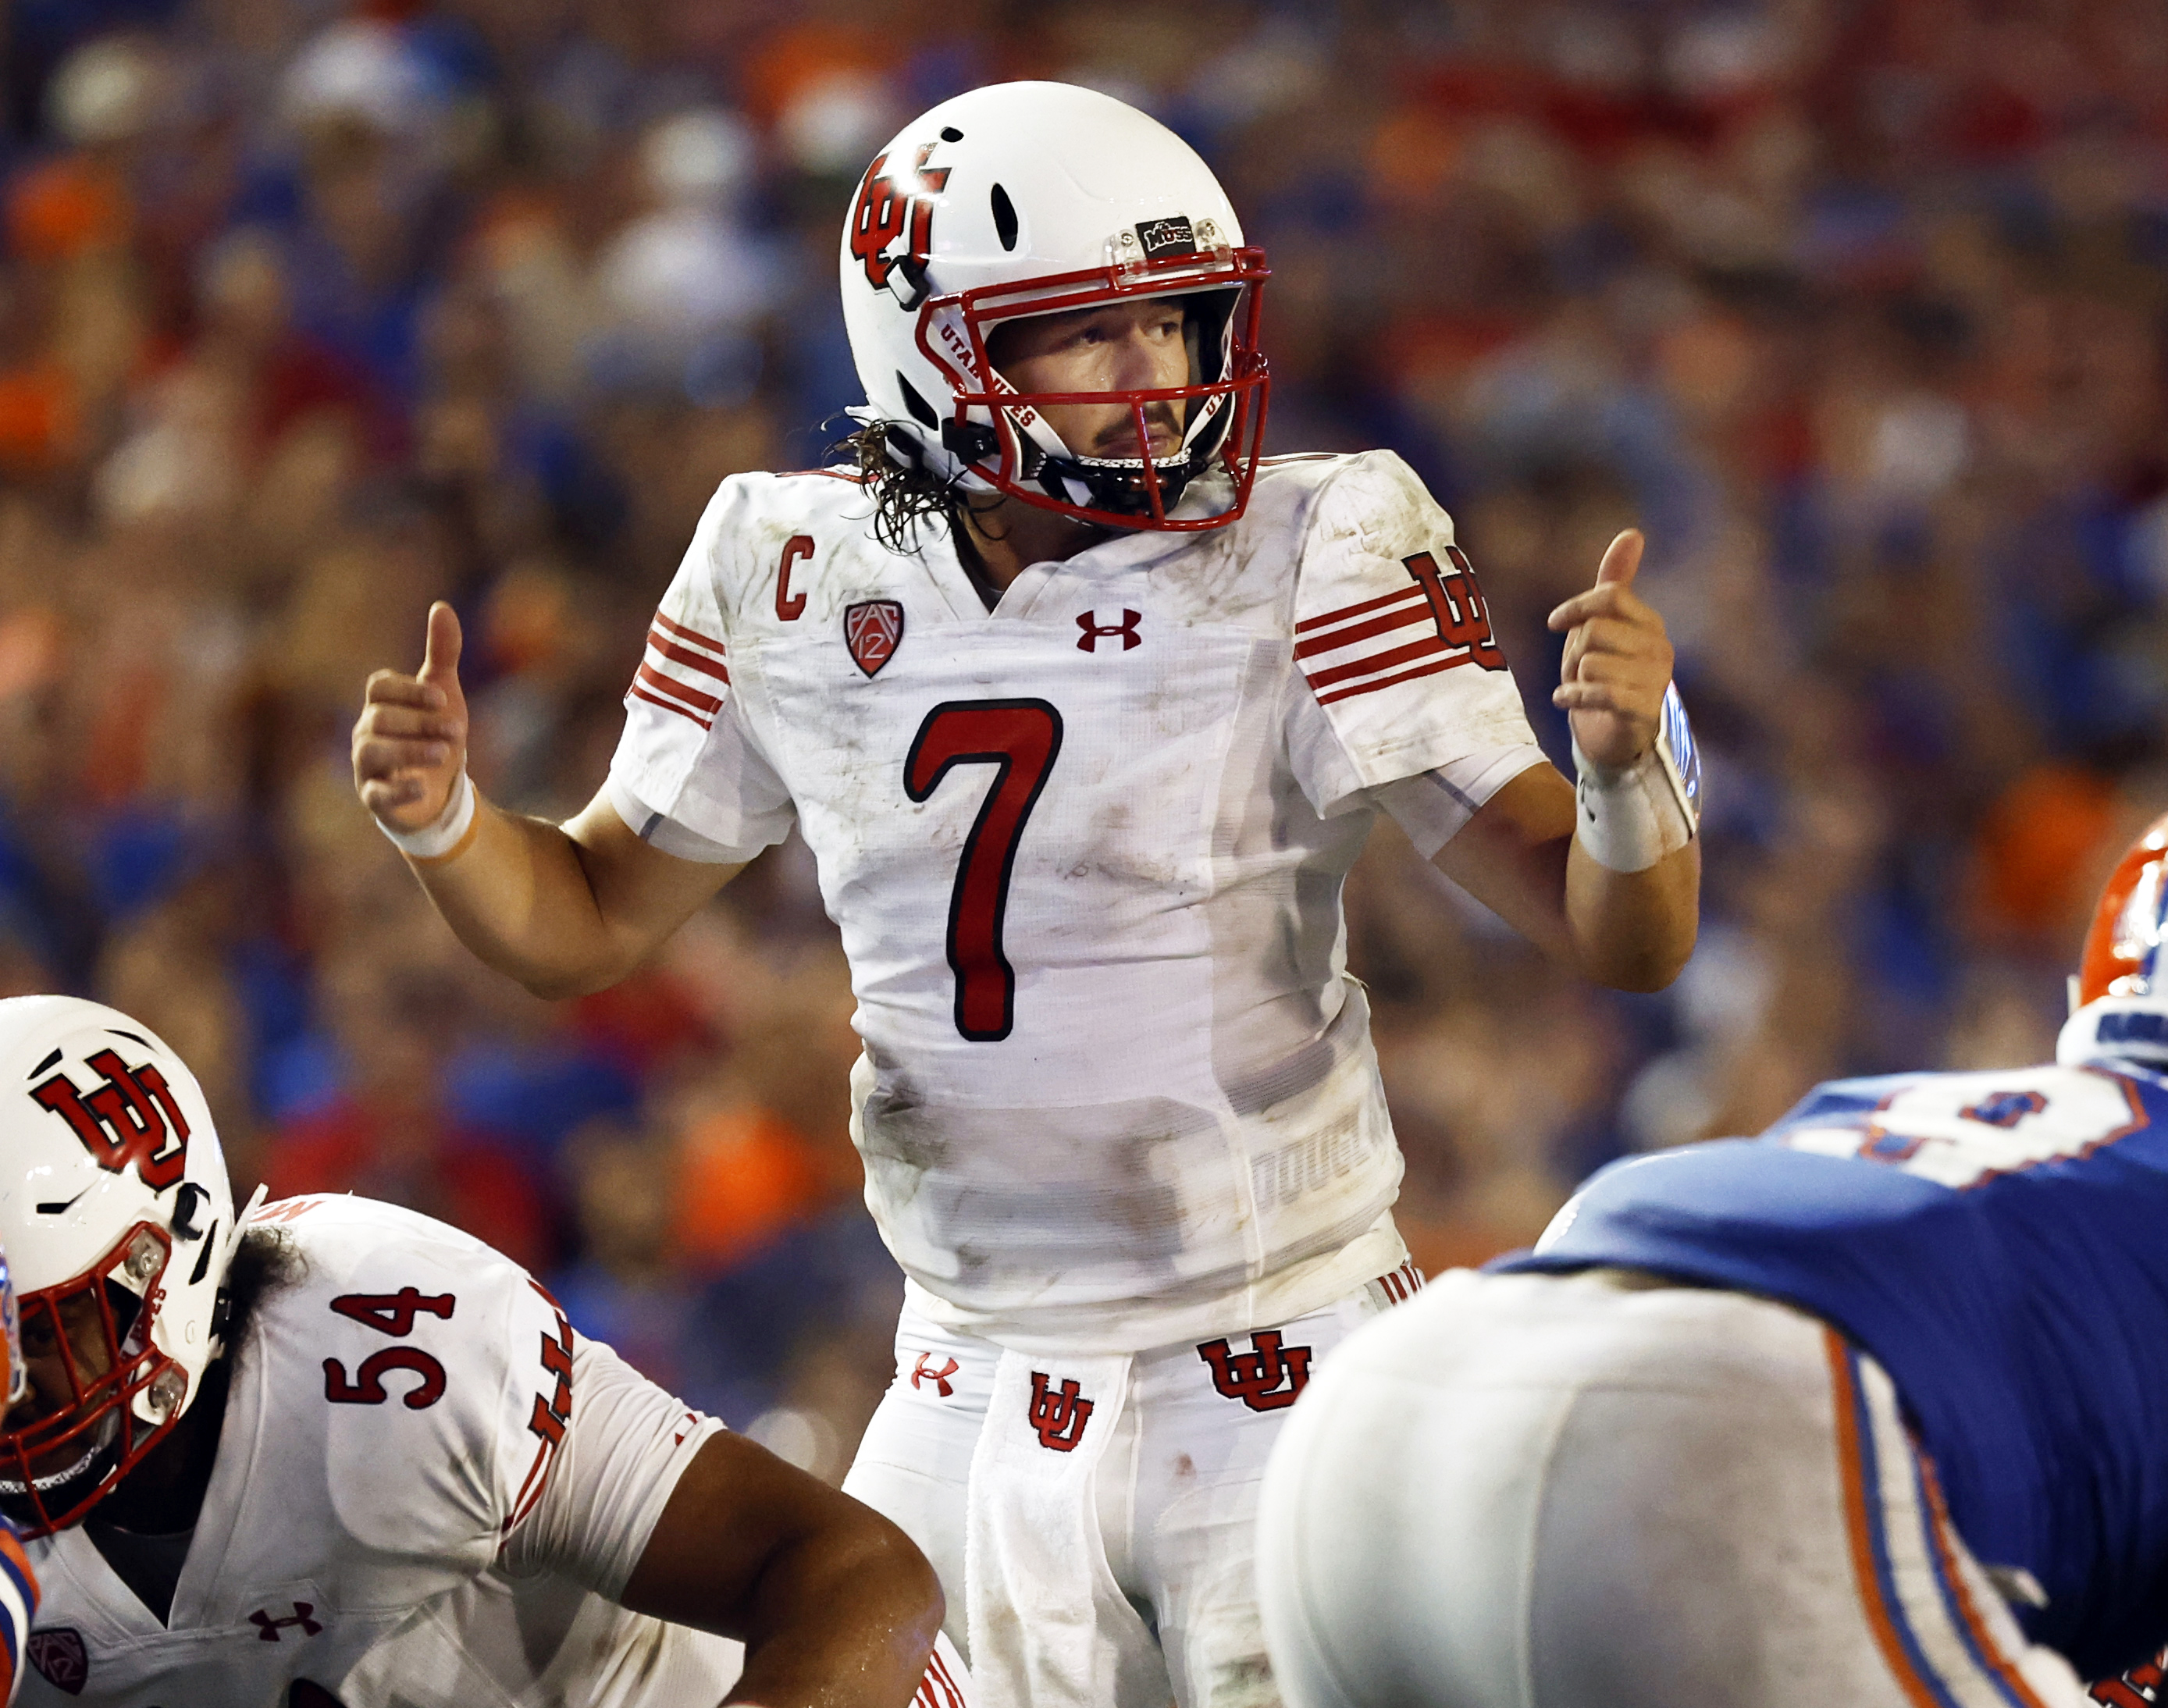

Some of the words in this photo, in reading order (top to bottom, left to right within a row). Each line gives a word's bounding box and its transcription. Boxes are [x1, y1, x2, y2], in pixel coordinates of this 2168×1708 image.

[775, 535, 815, 621] C
[847, 603, 898, 648] PAC
[858, 632, 887, 660] 12
[902, 697, 1064, 1042] 7
[322, 1286, 456, 1410] 54
